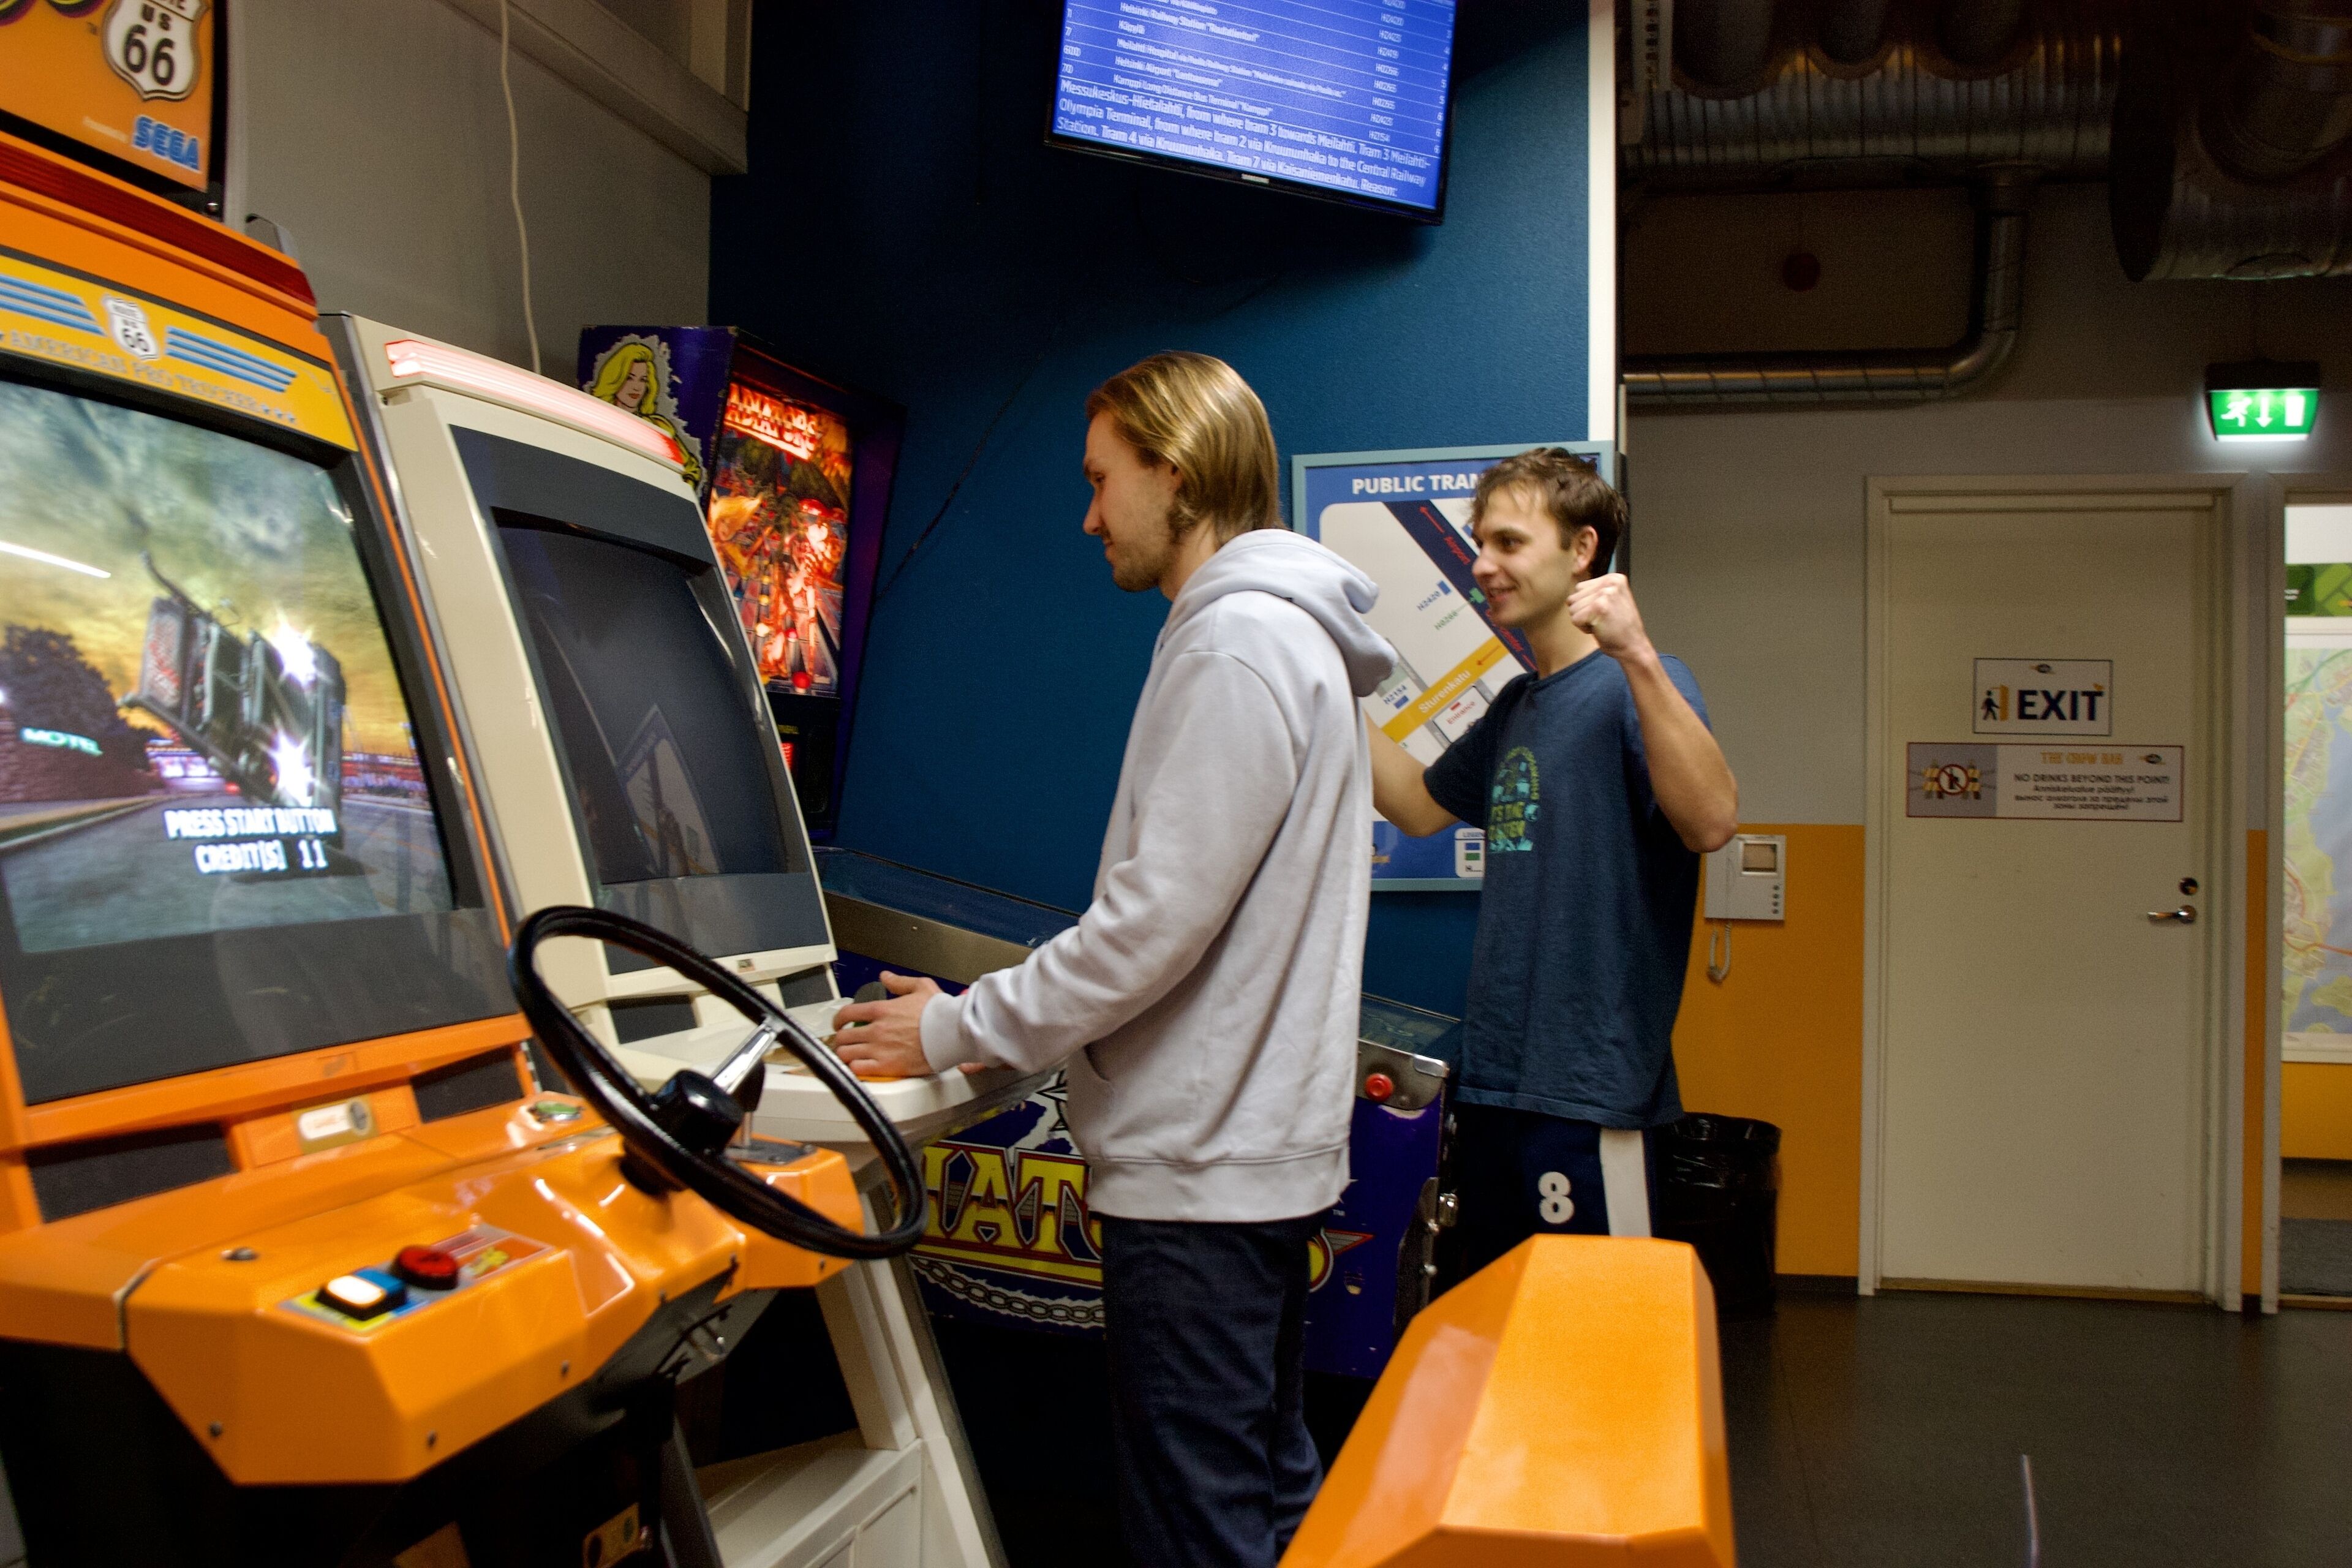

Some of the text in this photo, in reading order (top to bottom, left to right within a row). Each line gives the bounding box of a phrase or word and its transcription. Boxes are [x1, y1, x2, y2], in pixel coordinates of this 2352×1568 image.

[124, 24, 175, 86] 66
[132, 115, 202, 173] SEGA
[1059, 98, 1104, 118] Olympia
[1106, 107, 1153, 130] Terminal,
[1155, 117, 1180, 134] from
[1180, 124, 1213, 140] where
[1213, 130, 1238, 146] tram
[1238, 135, 1247, 148] 2
[1248, 137, 1263, 152] via
[1327, 154, 1339, 167] to
[1339, 156, 1357, 171] the
[1357, 160, 1390, 178] Central
[1390, 167, 1427, 187] Railway
[1101, 125, 1128, 142] Tram
[1128, 130, 1138, 144] 4
[1138, 133, 1155, 148] via
[1226, 150, 1252, 167] Tram
[1252, 156, 1261, 168] 7
[1261, 158, 1277, 172] via
[1186, 105, 1212, 123] from
[1212, 113, 1244, 129] where
[1244, 119, 1269, 135] tram
[1268, 123, 1278, 136] 3
[1278, 125, 1317, 145] towards
[1359, 143, 1382, 159] Tram
[1382, 148, 1390, 160] 3
[123, 326, 150, 353] 66
[1352, 475, 1425, 495] PUBLIC
[1418, 669, 1471, 714] Sturenkatu
[2017, 690, 2105, 722] EXIT
[1446, 701, 1476, 725] Entrance
[2014, 774, 2030, 782] NO
[2032, 774, 2068, 783] DRINKS
[2070, 774, 2111, 783] BEYOND
[2114, 774, 2135, 783] THIS
[164, 808, 337, 839] PRESS START BUTTON
[298, 839, 328, 870] 11
[1538, 1171, 1575, 1224] 8
